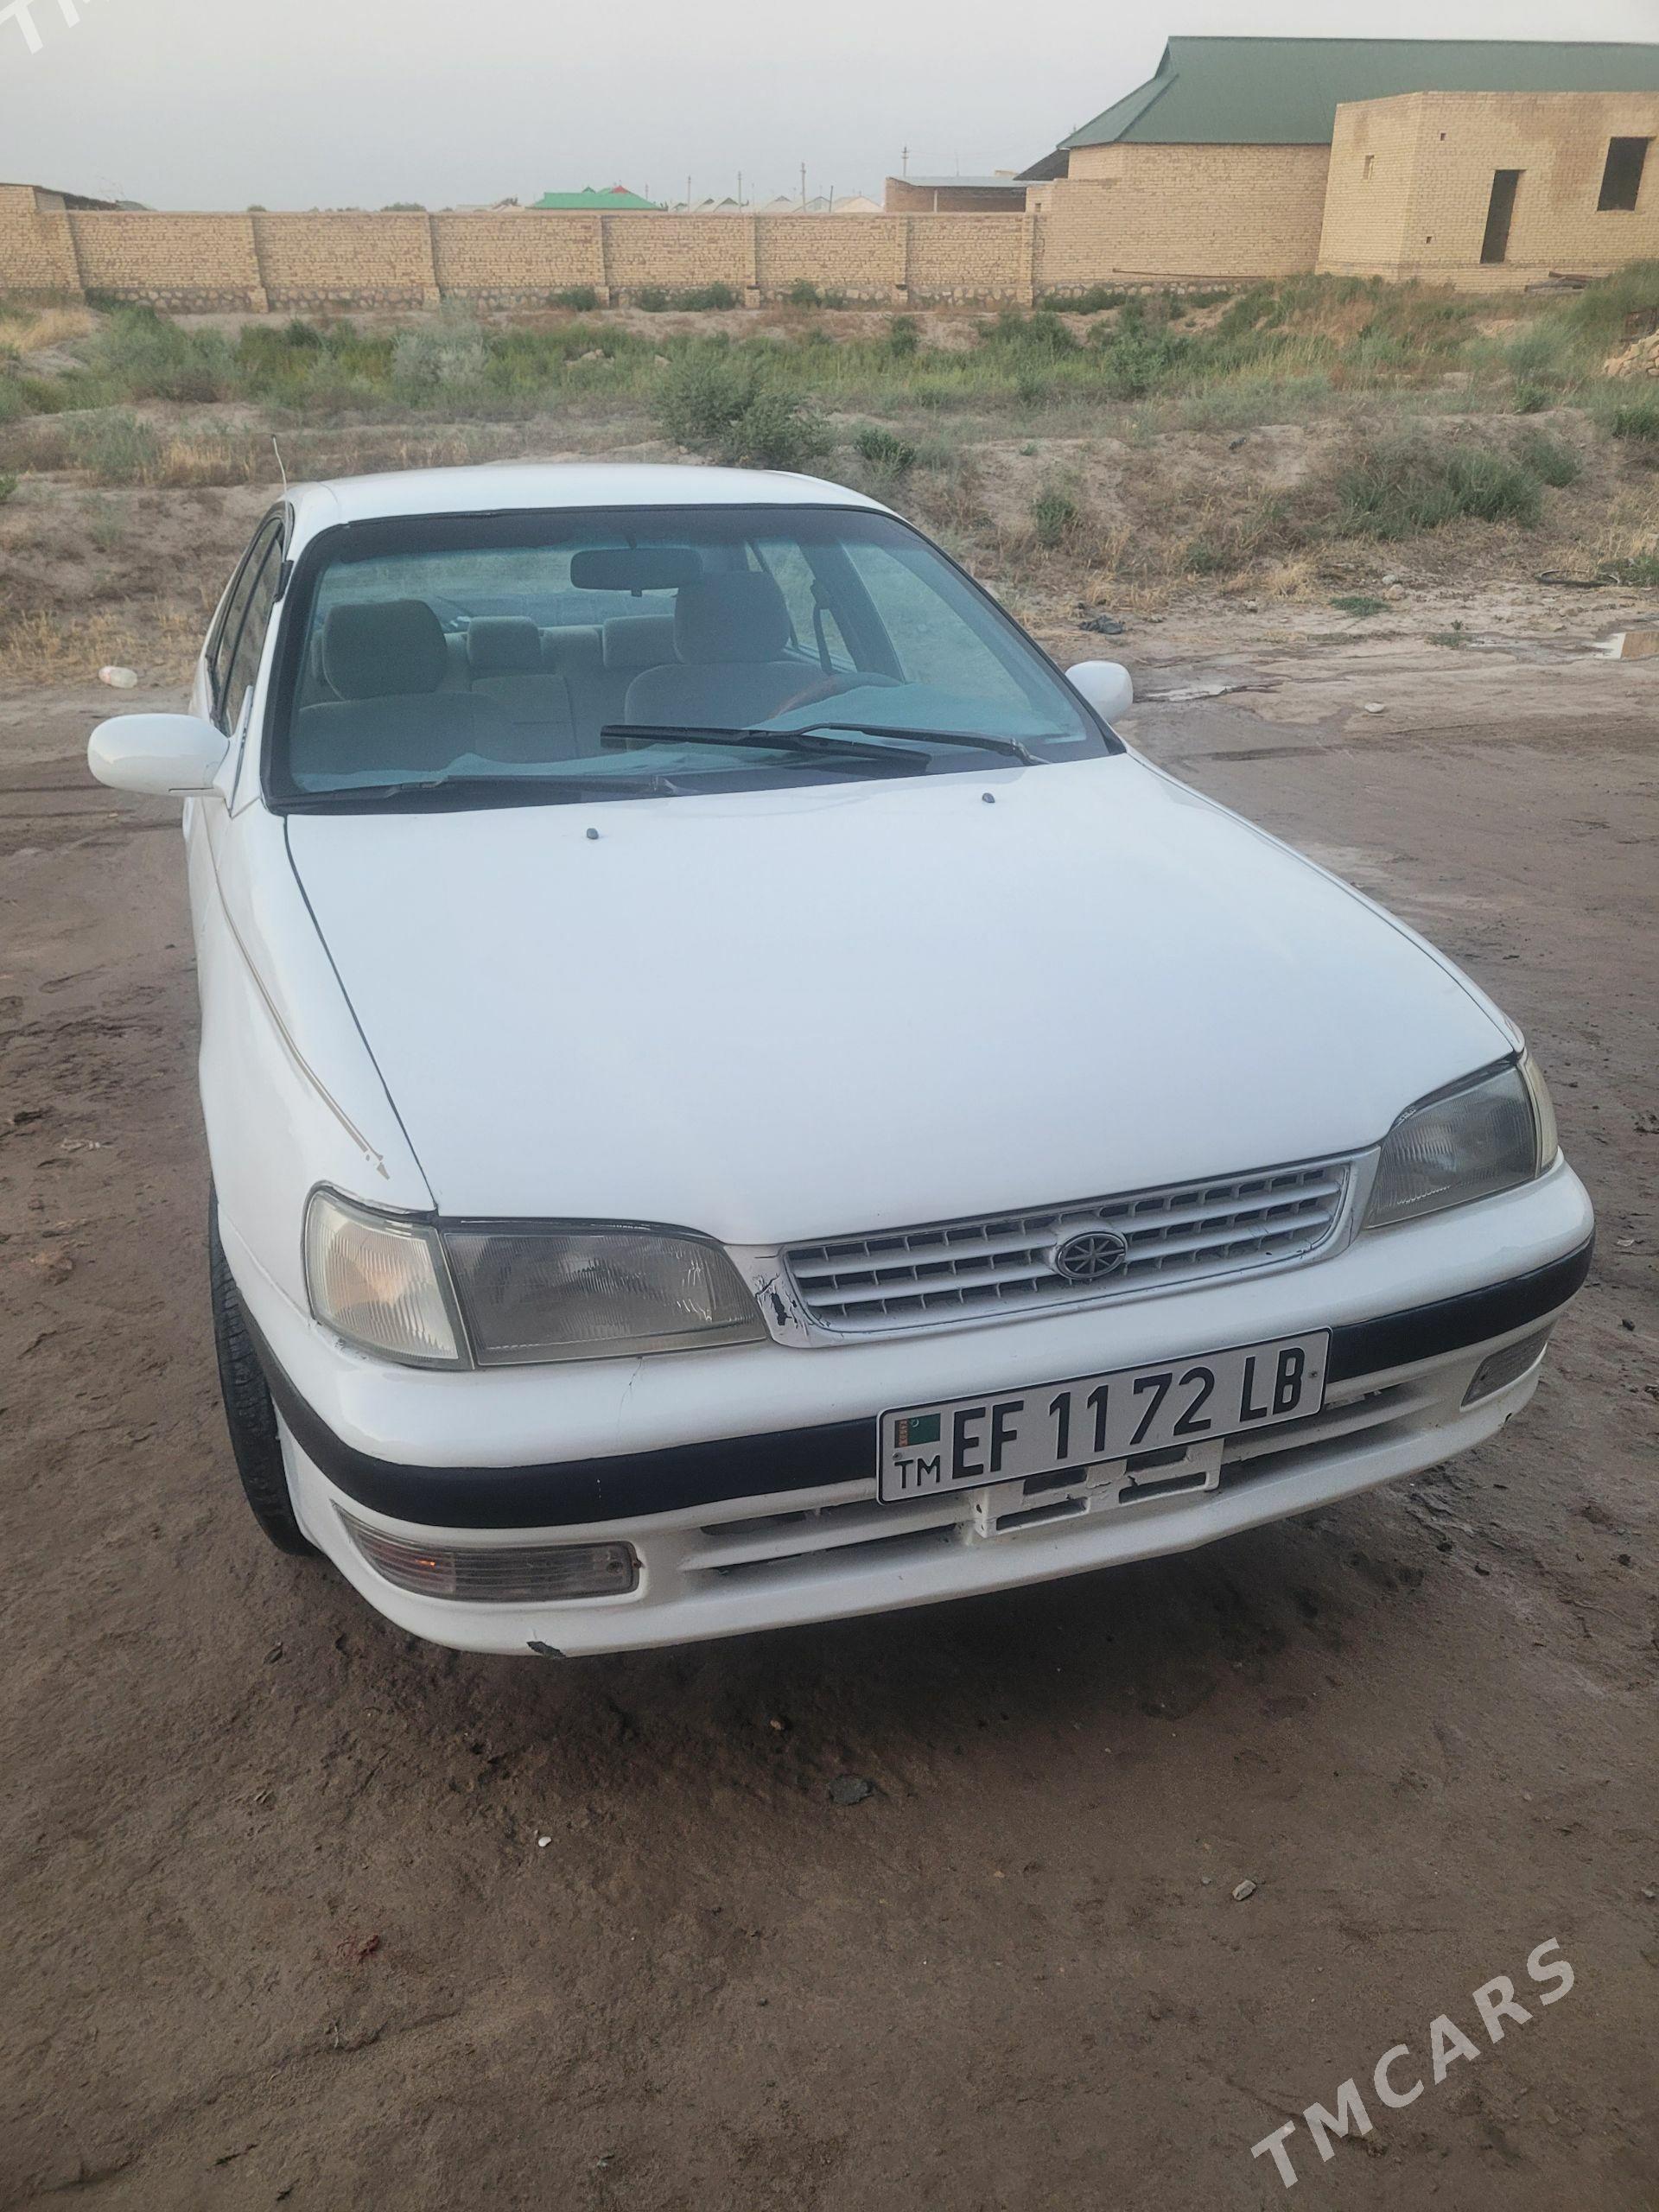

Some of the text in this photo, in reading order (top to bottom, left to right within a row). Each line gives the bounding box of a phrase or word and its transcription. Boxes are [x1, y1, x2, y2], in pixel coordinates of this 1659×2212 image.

[952, 1347, 1305, 1478] EF 1172 LB
[894, 1455, 941, 1489] TM
